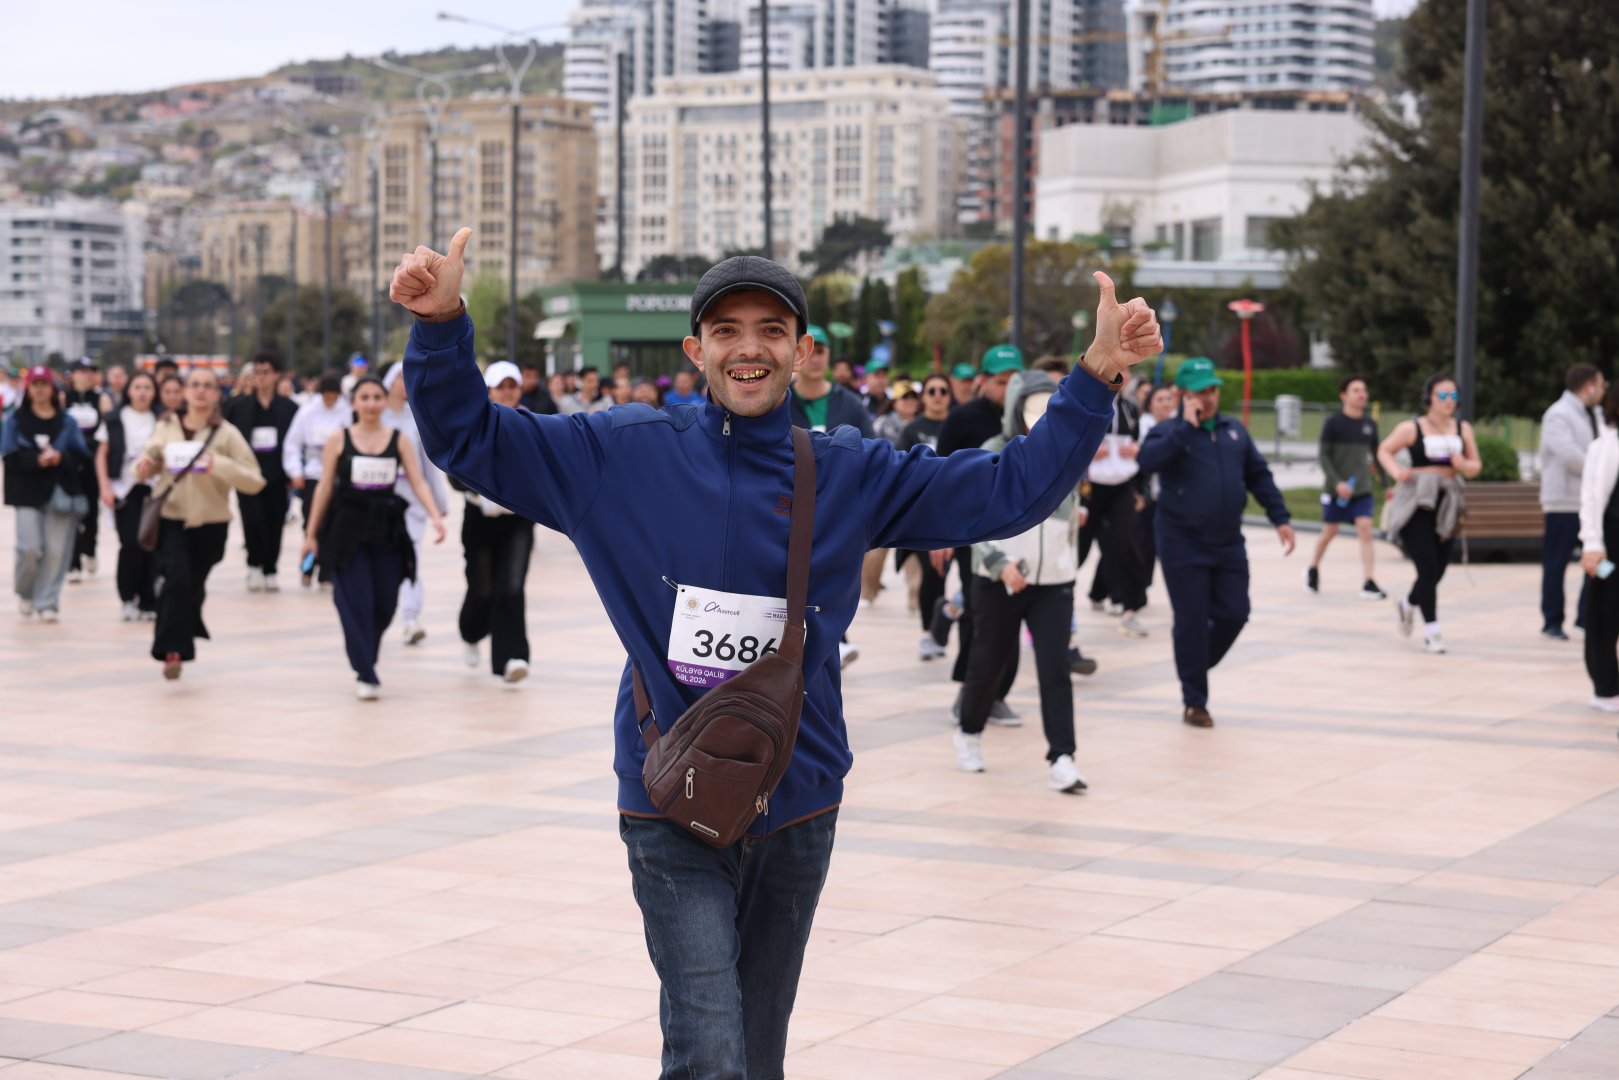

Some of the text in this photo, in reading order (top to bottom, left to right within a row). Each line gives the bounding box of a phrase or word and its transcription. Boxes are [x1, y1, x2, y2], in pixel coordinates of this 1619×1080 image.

[692, 629, 778, 664] 3686
[675, 673, 707, 684] GƏL 2026
